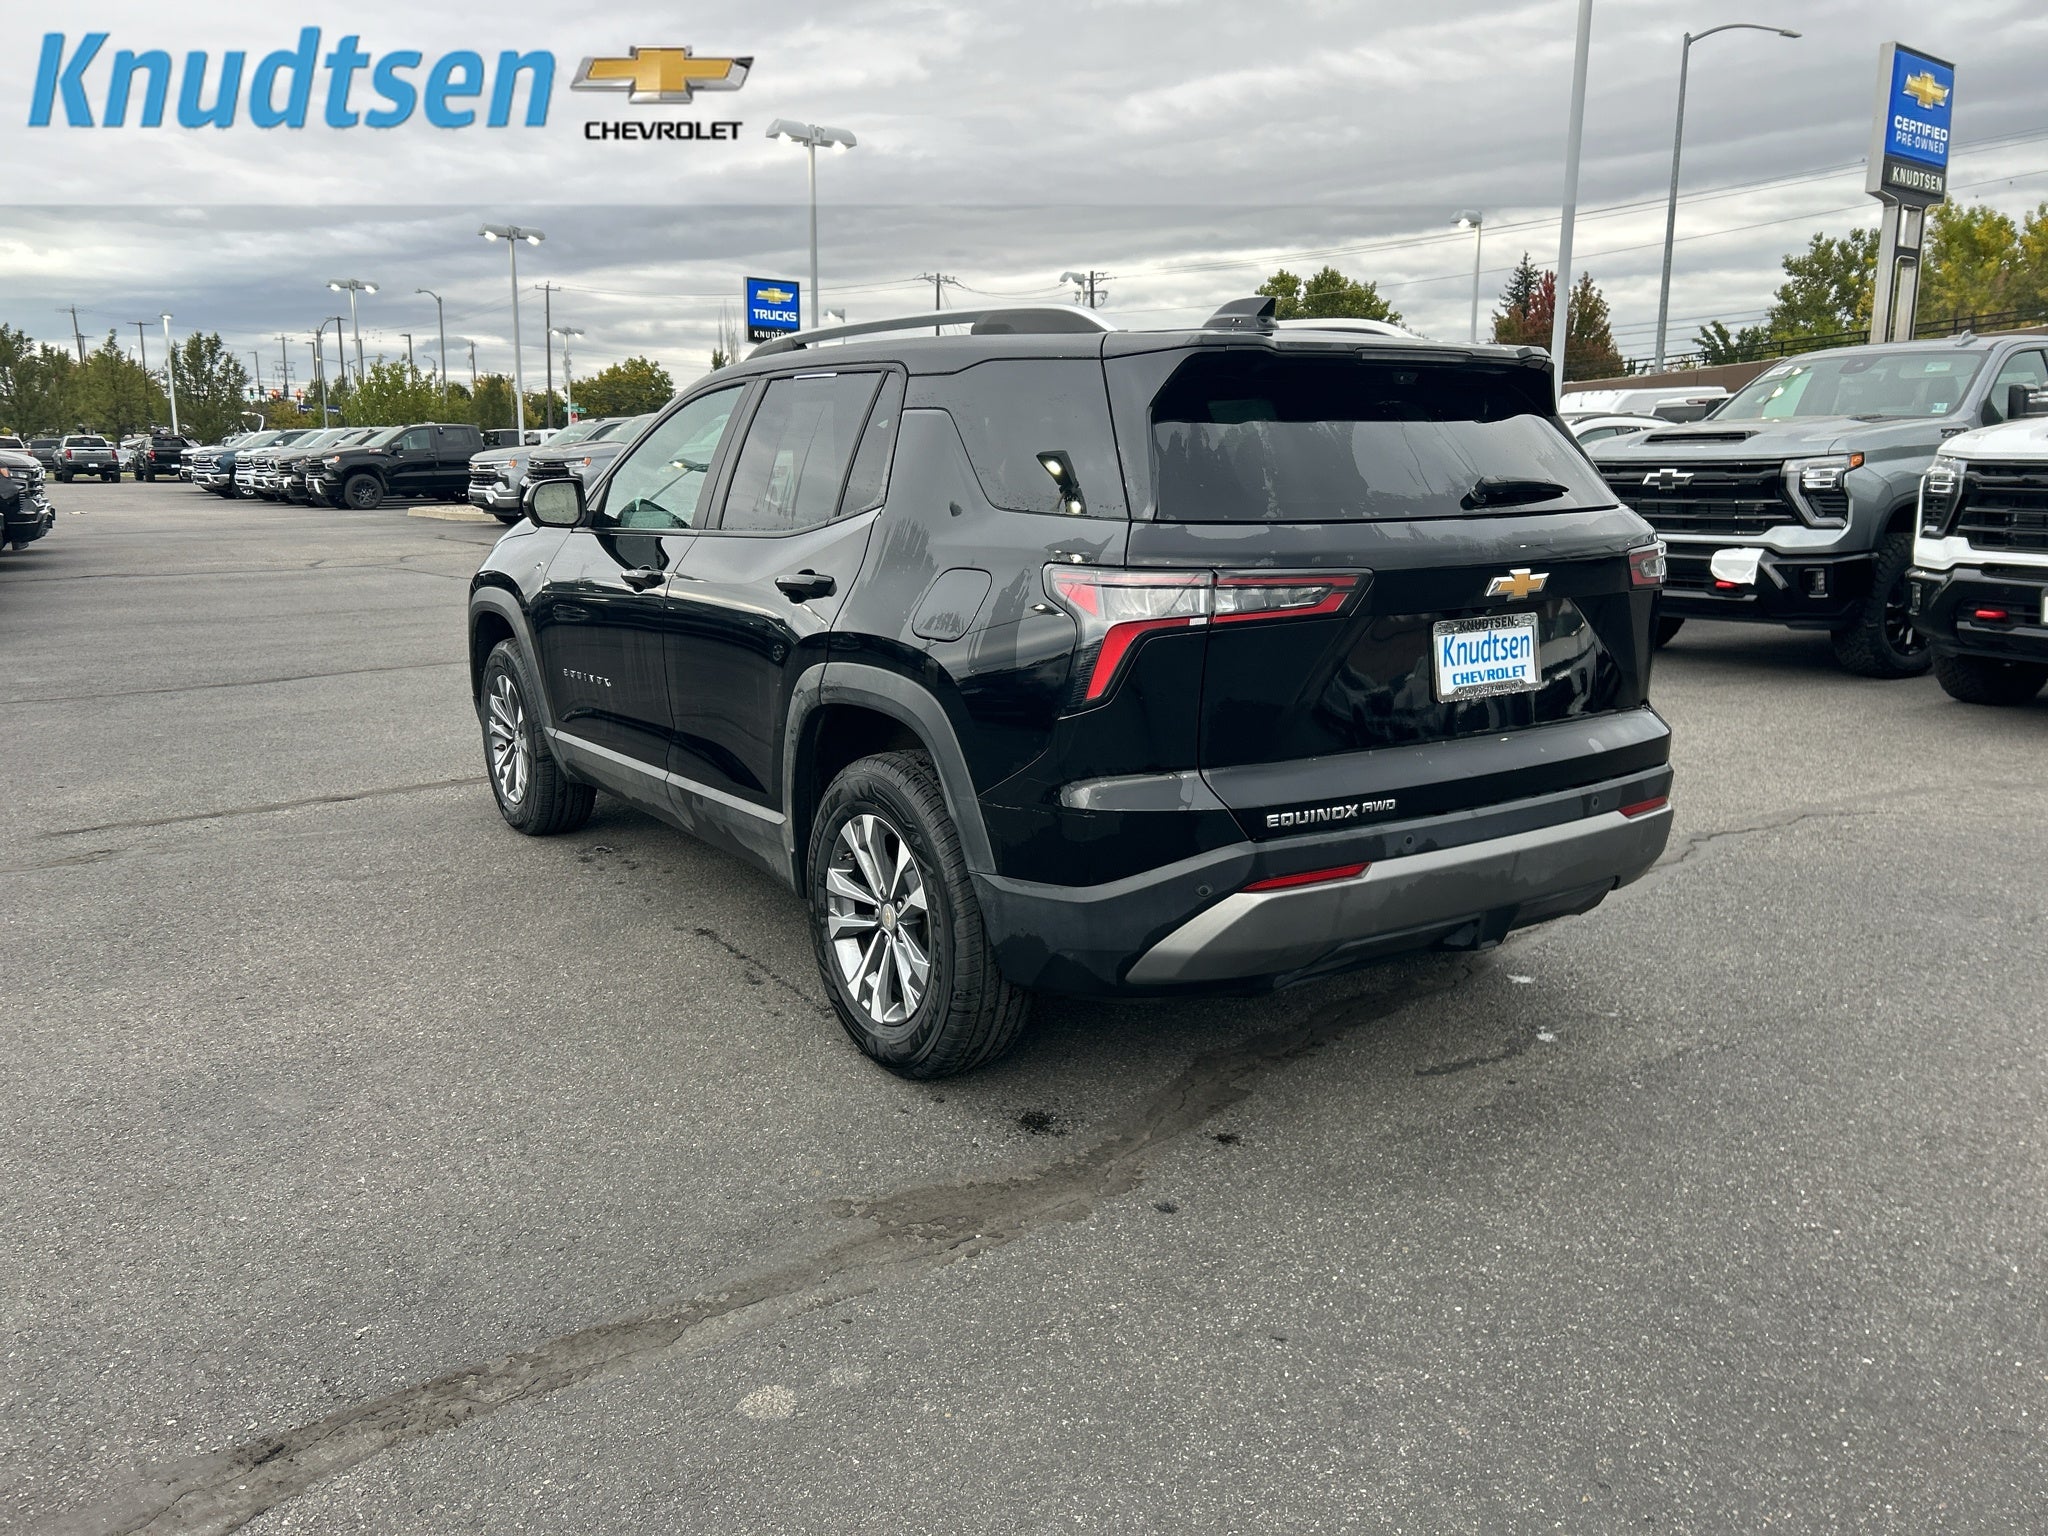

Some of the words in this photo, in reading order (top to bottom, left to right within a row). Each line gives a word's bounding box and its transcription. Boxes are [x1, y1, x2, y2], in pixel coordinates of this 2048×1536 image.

[1894, 114, 1949, 142] CERTIFIED
[1896, 131, 1944, 155] PRE-OWNED
[1892, 166, 1943, 192] KNUDTSEN
[753, 308, 797, 322] TRUCKS
[1460, 616, 1515, 633] KNUDTSEN
[1443, 630, 1530, 668] Knudtsen
[1452, 664, 1527, 686] CHEVROLET
[1266, 803, 1358, 828] EQUINOX
[1361, 798, 1396, 814] AWD
